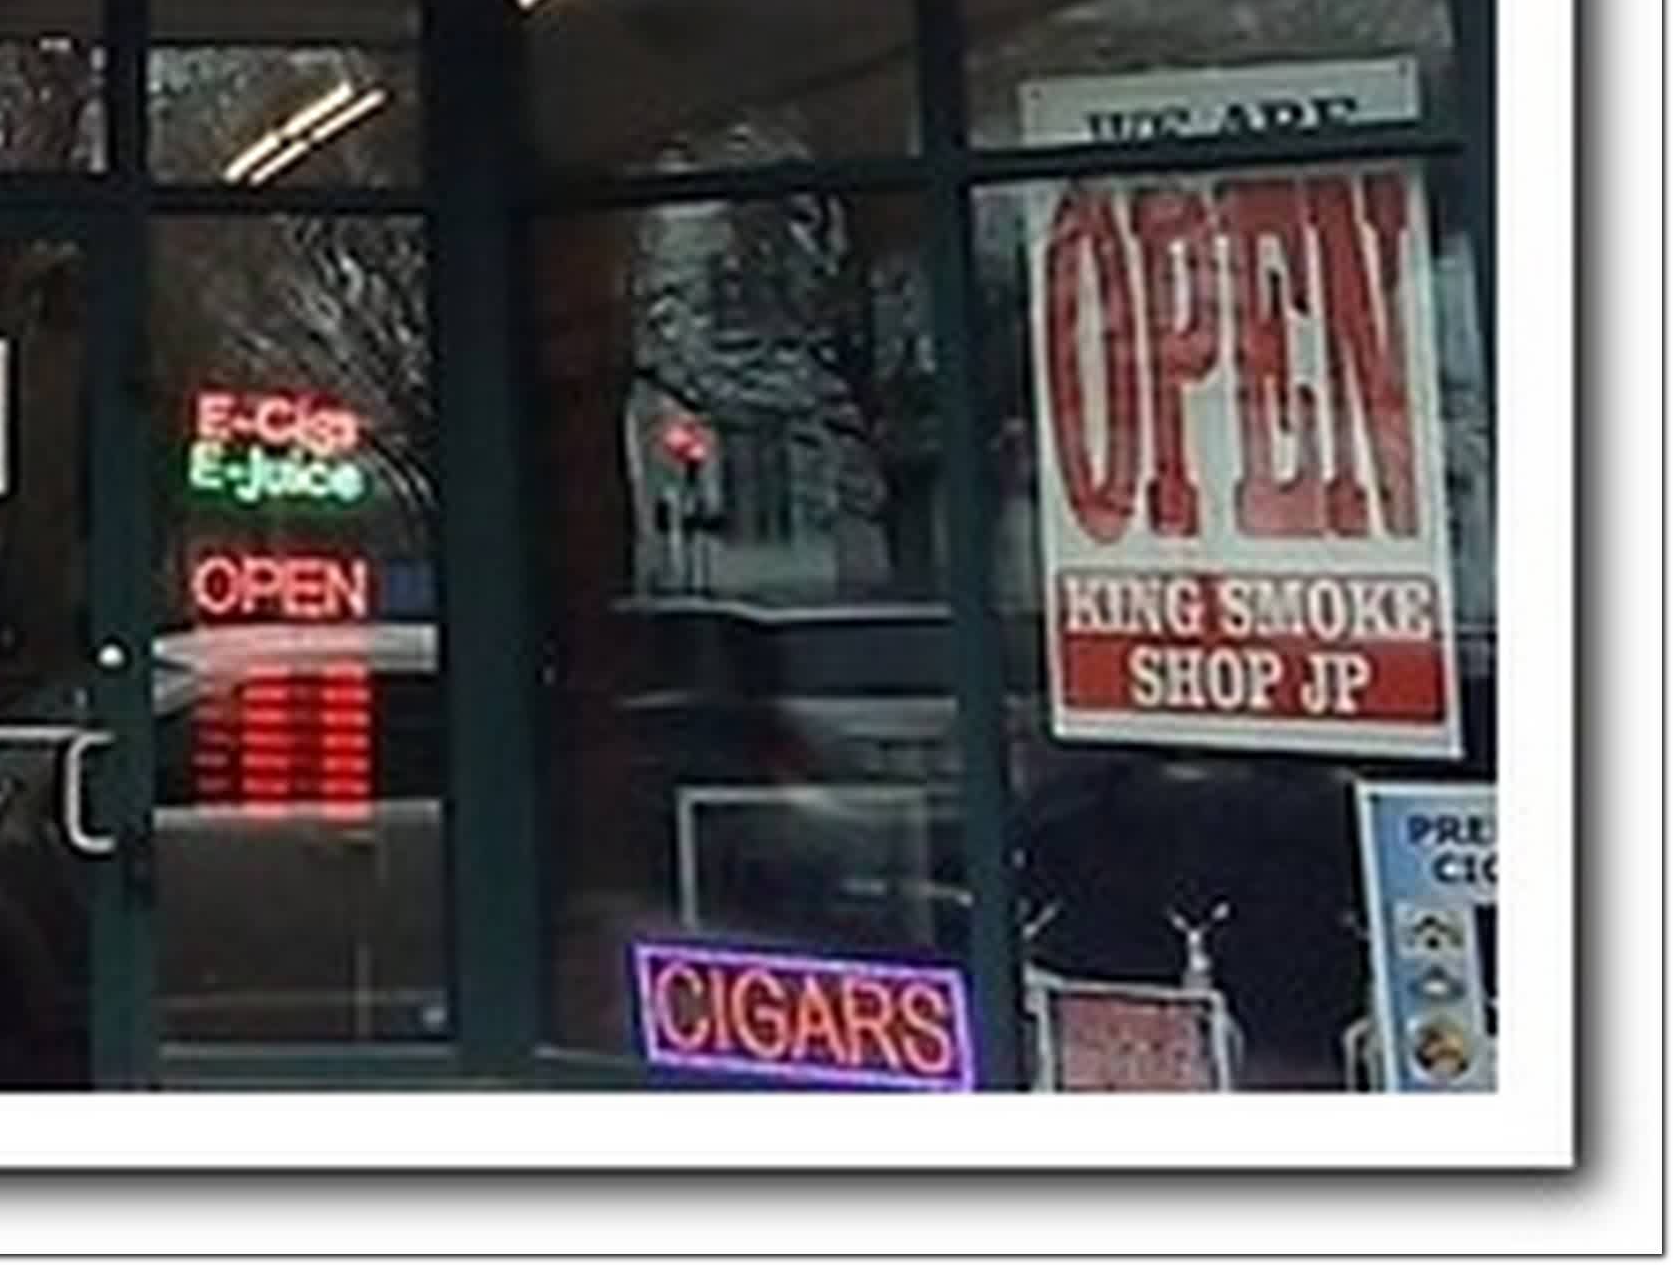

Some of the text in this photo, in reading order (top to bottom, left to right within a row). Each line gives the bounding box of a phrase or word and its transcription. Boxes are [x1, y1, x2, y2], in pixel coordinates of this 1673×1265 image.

[1045, 173, 1420, 543] OPEN
[193, 555, 368, 618] OPEN
[1067, 576, 1433, 642] KING SMOKE
[1129, 644, 1371, 714] SHOP JP
[653, 960, 953, 1074] CIGARS
